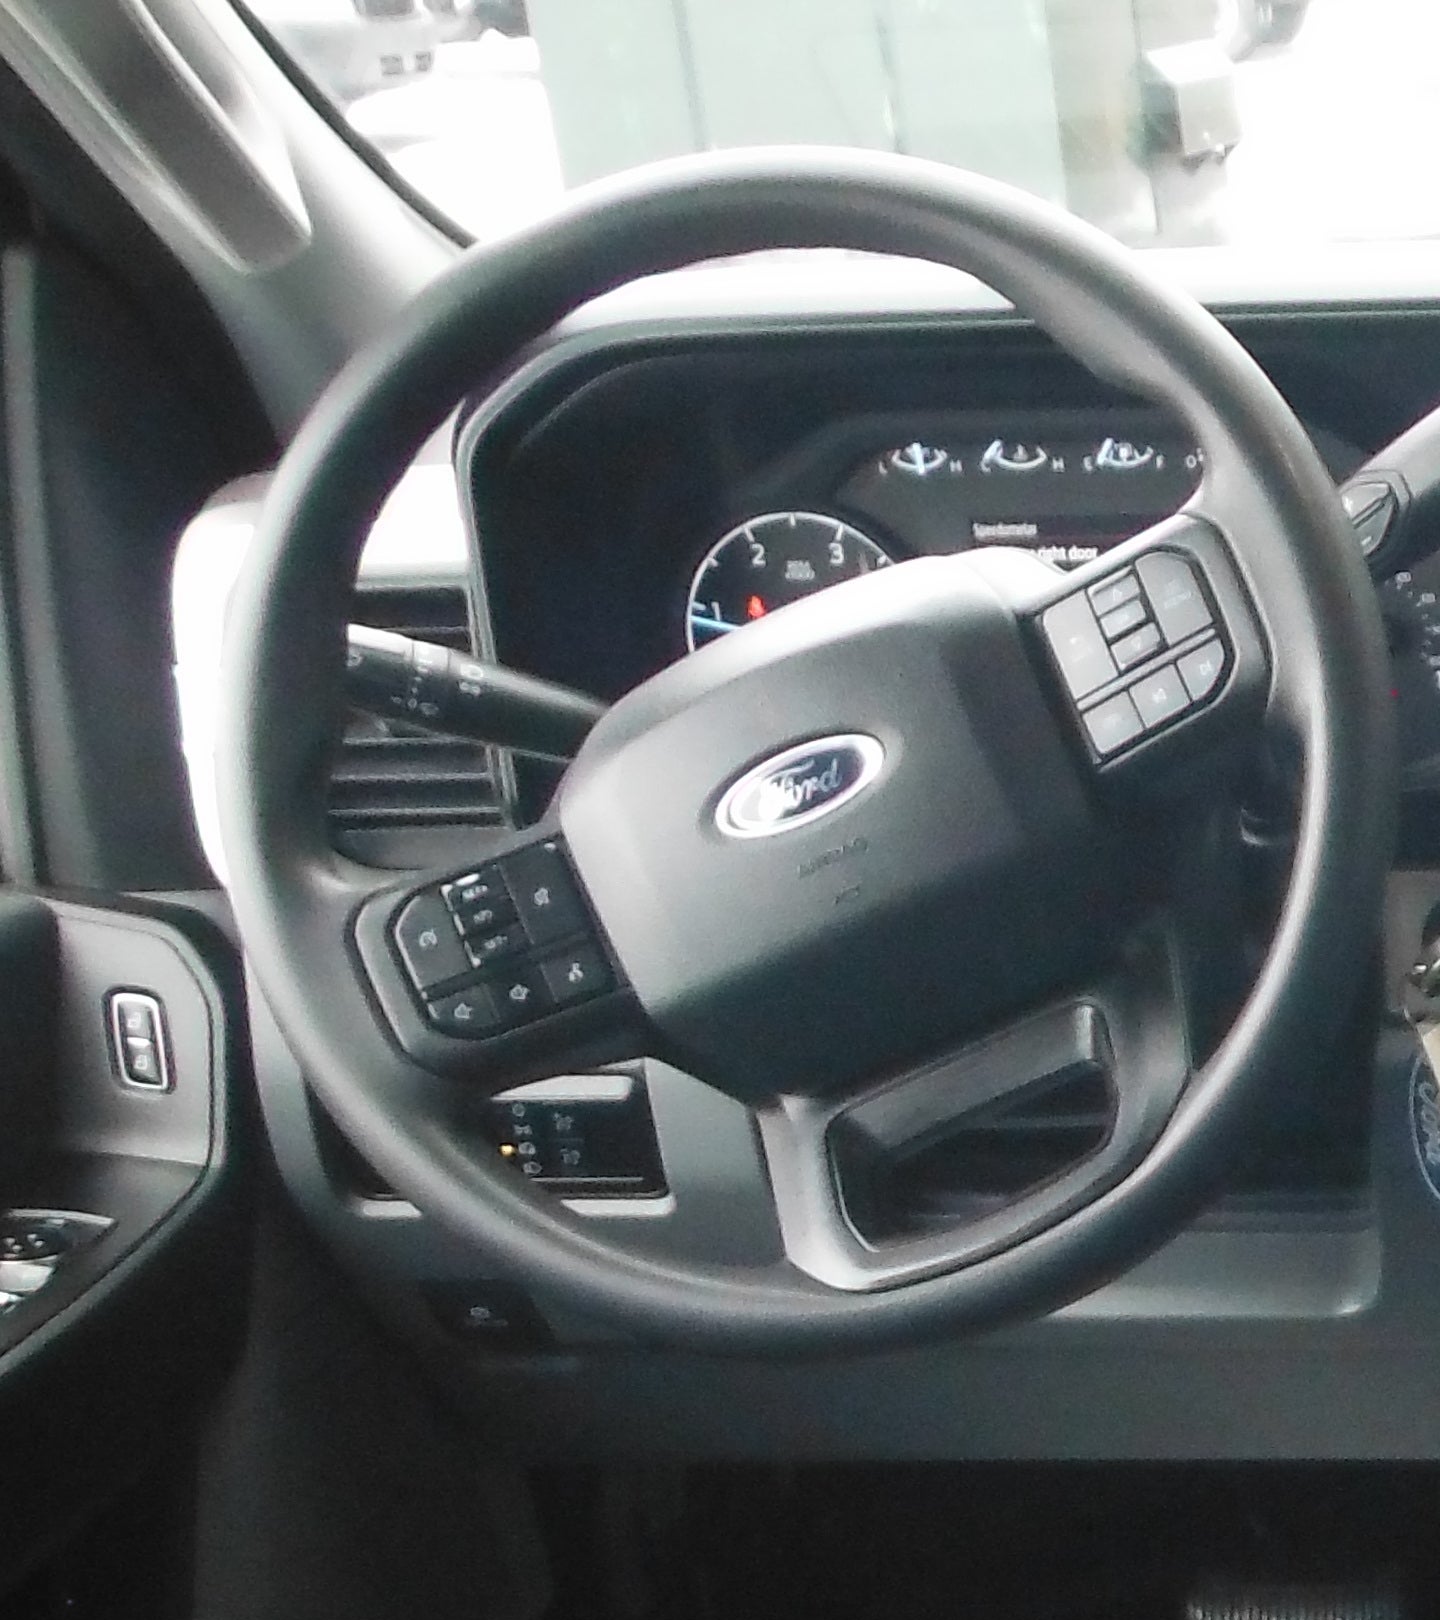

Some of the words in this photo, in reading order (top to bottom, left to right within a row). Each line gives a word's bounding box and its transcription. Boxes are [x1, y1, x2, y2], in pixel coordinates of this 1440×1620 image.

[751, 542, 767, 568] 2
[828, 542, 845, 565] 3
[1068, 544, 1099, 560] door
